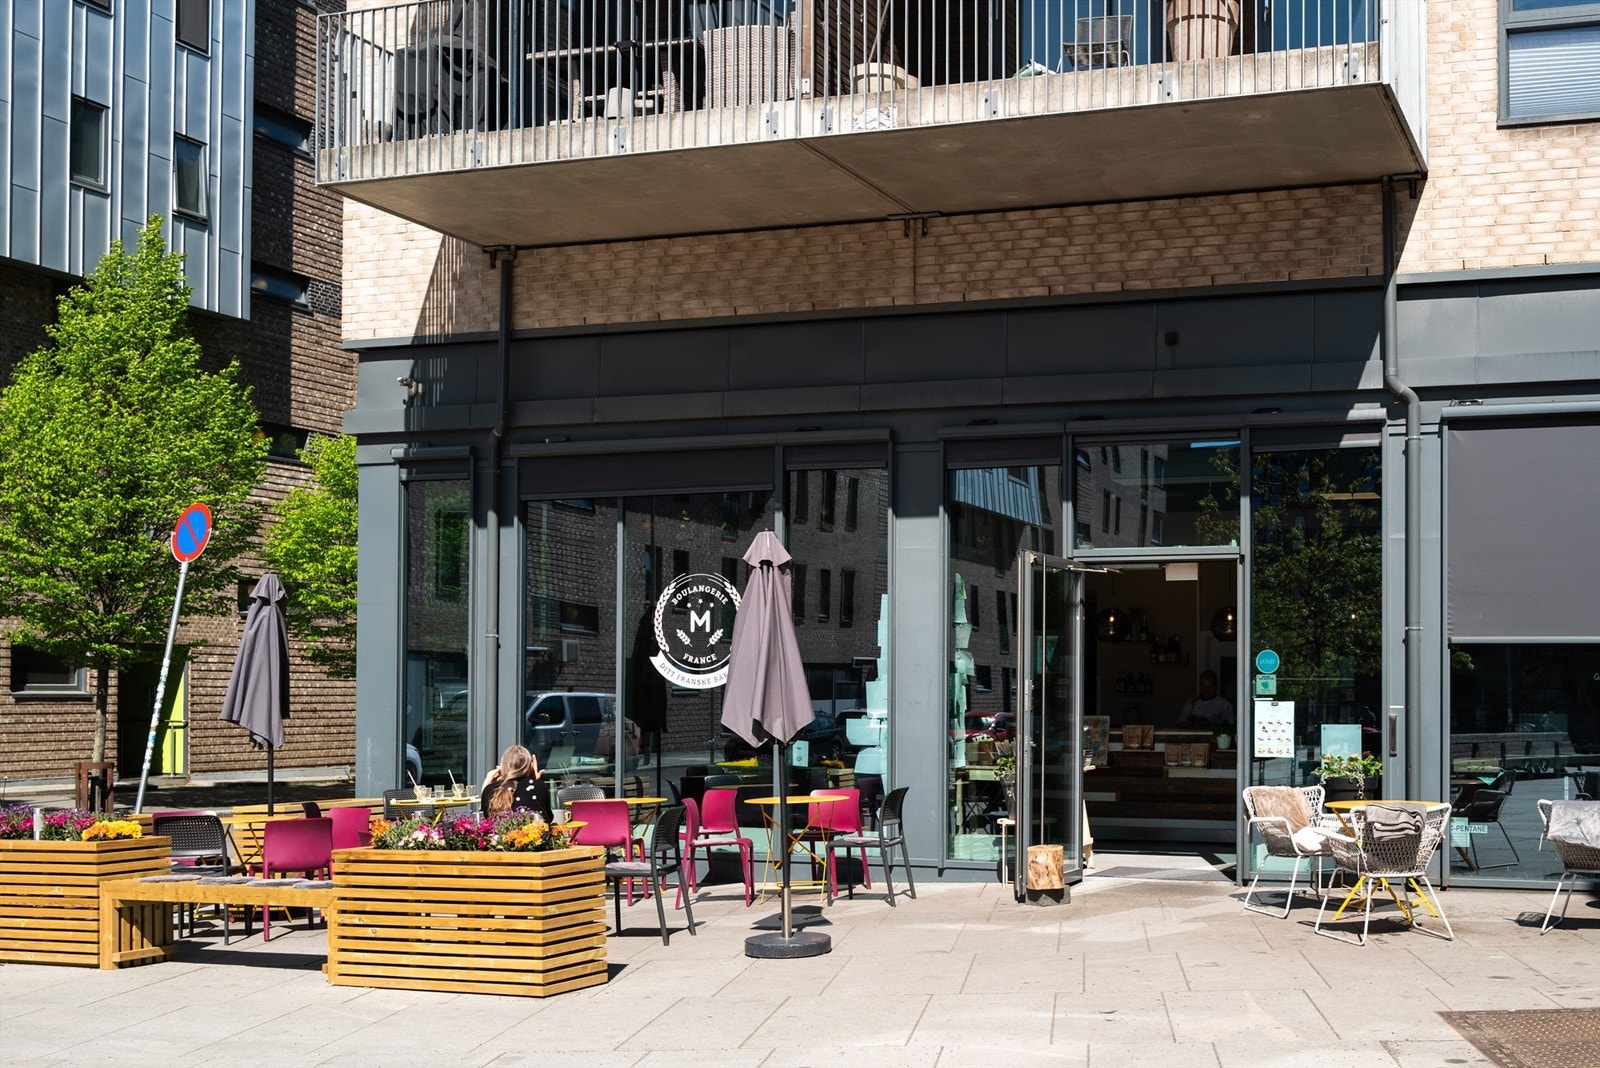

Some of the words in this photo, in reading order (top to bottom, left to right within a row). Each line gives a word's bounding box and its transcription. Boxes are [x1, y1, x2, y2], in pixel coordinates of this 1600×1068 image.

[671, 585, 729, 605] BOULANGERIE
[690, 610, 711, 633] M
[683, 653, 717, 664] FRANCE
[660, 662, 675, 677] DITT
[676, 675, 711, 686] FRANSKE
